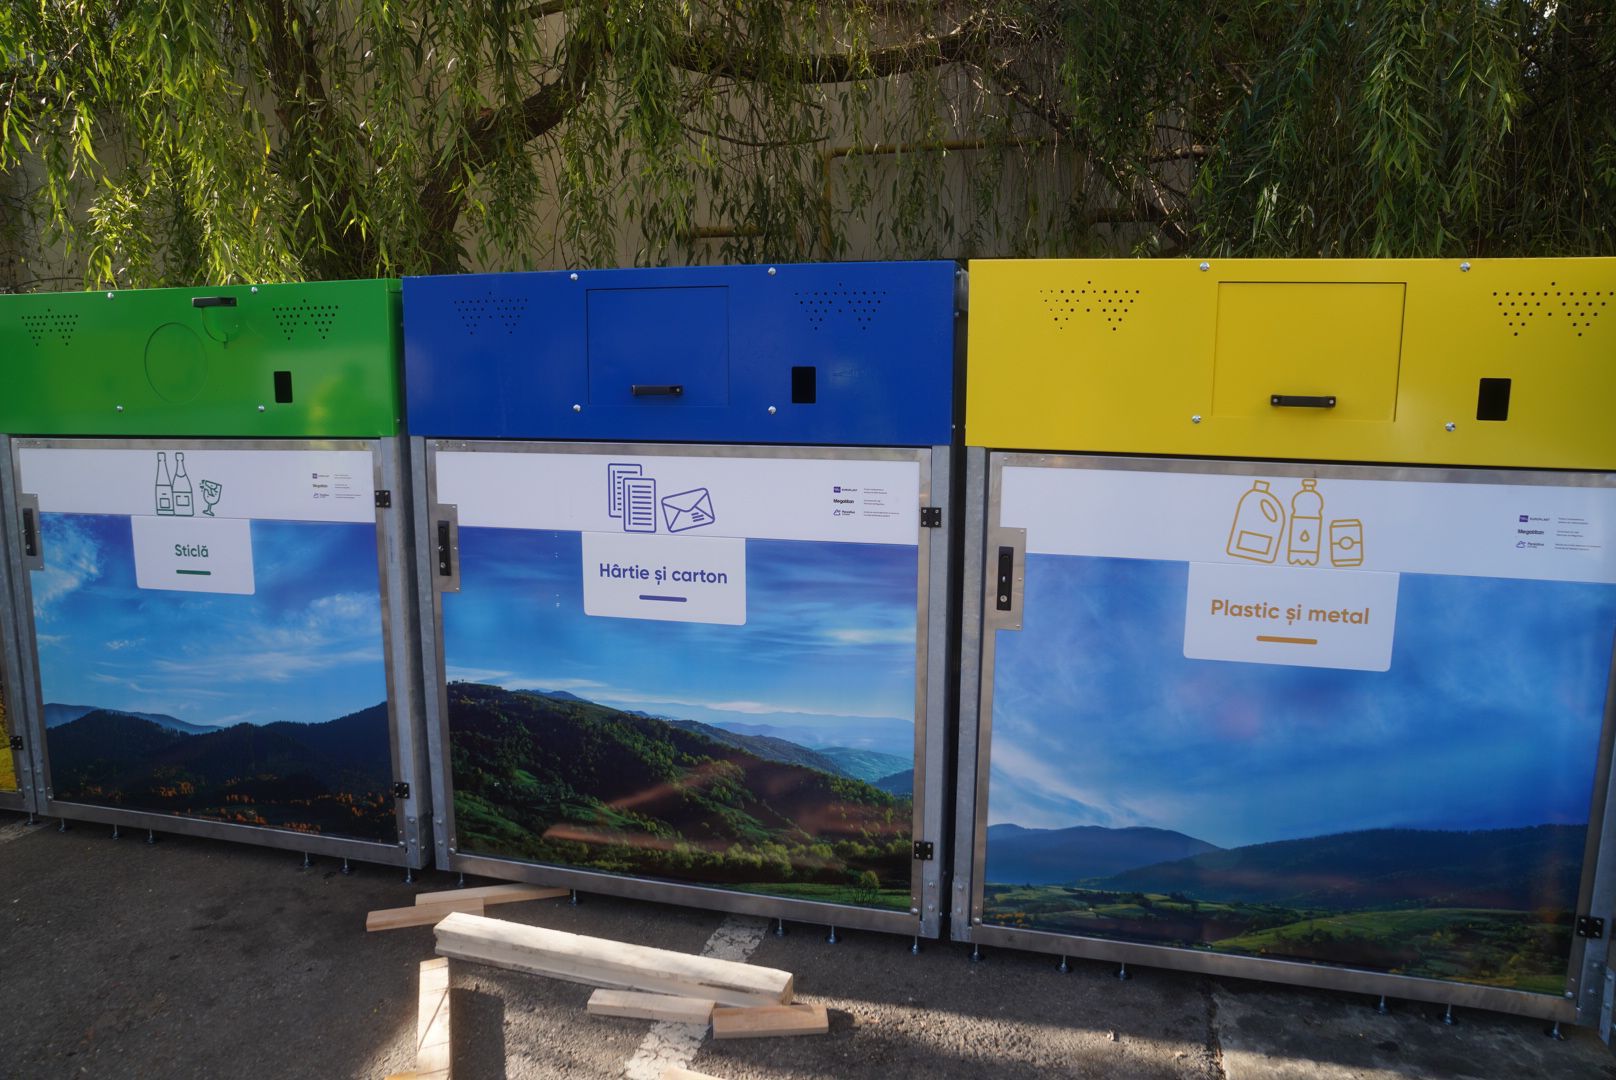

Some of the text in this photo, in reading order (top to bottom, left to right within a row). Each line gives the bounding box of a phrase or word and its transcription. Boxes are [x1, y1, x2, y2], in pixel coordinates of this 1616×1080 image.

[175, 544, 209, 558] Sticlă
[599, 563, 728, 585] Hârtie și carton
[1211, 599, 1370, 626] Plastic și metal
